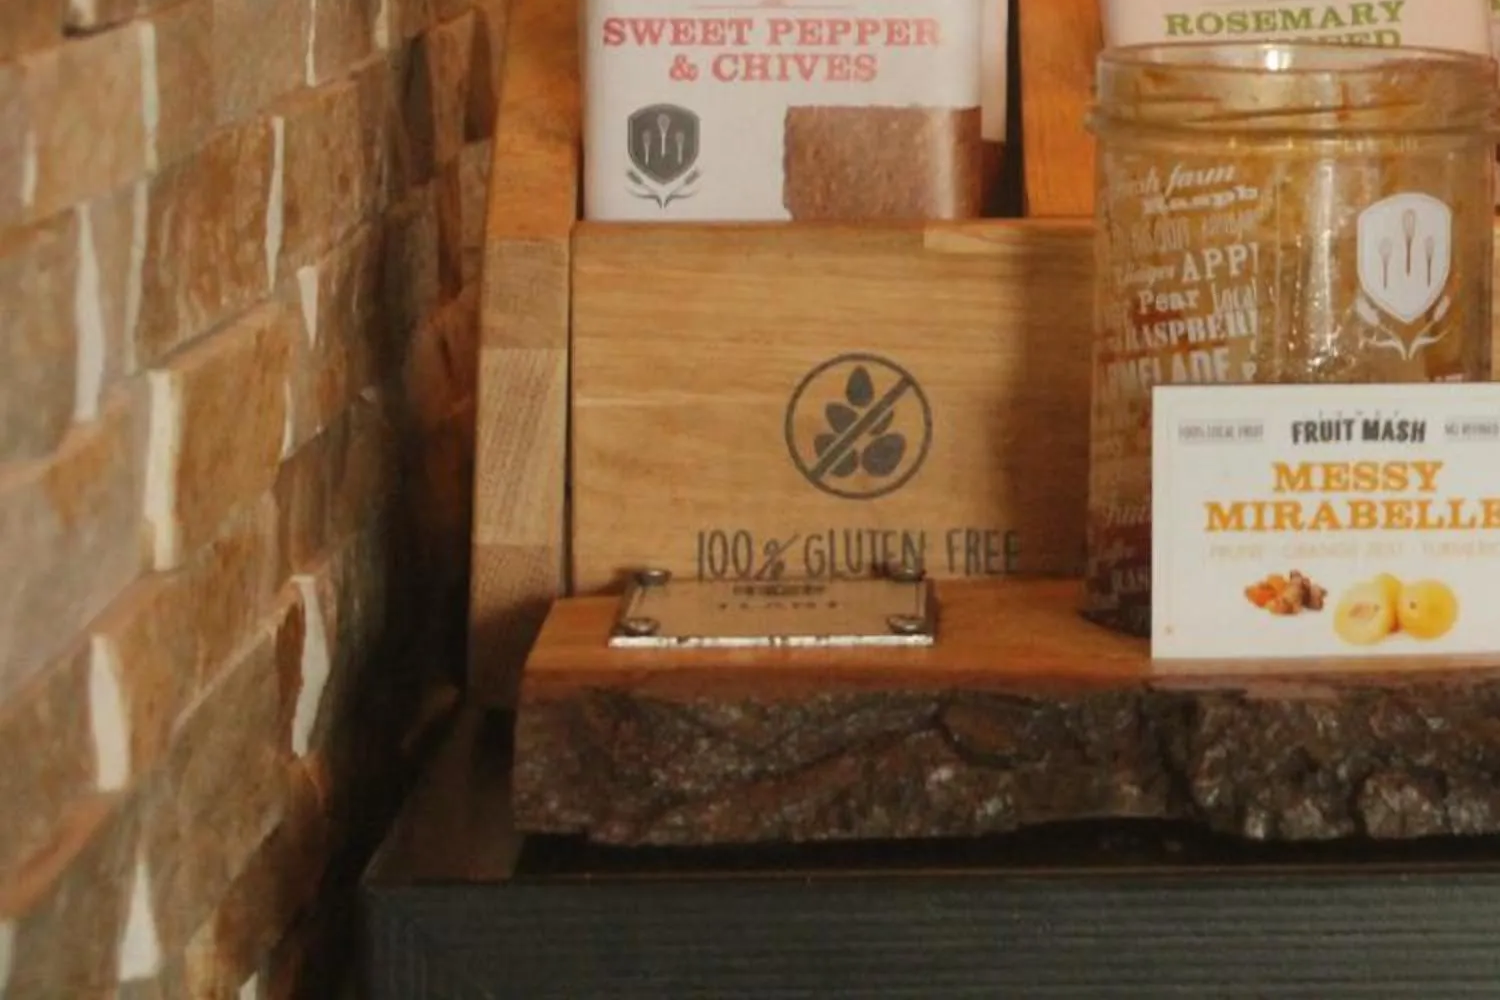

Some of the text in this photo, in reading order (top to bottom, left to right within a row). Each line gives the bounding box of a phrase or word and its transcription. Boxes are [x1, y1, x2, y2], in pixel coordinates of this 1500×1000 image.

[603, 17, 942, 47] SWEET PEPPER
[1163, 0, 1405, 36] ROSEMARY
[669, 53, 878, 83] & CHIVES
[1292, 419, 1427, 445] FRUIT MASH
[1271, 460, 1444, 492] MESSY
[696, 527, 1020, 581] 100% GLUTEN FREE
